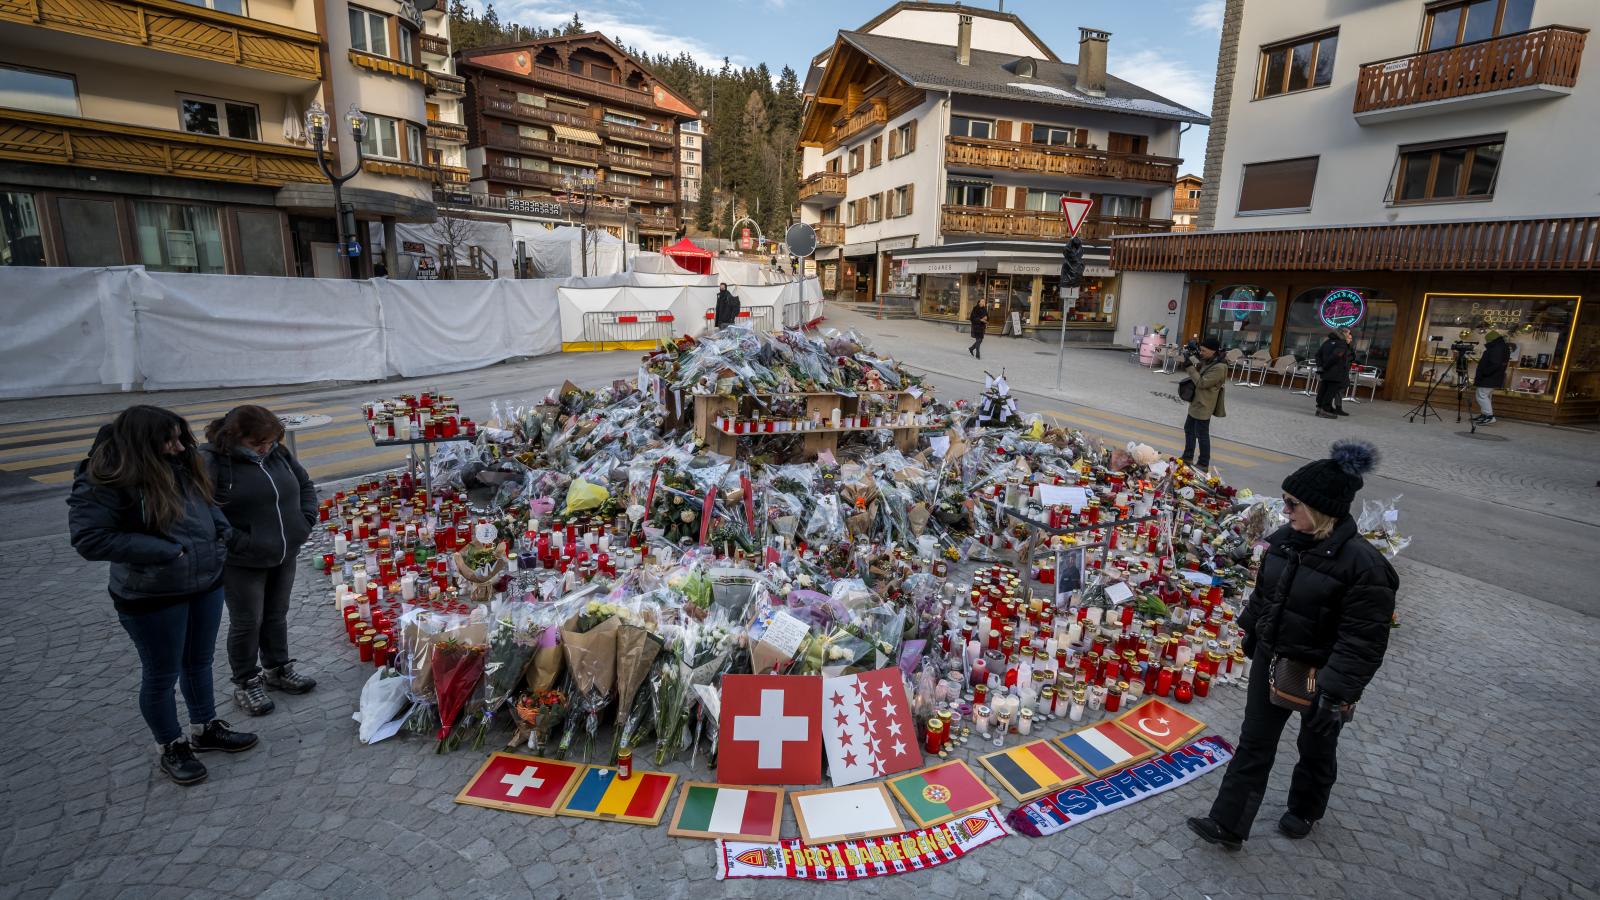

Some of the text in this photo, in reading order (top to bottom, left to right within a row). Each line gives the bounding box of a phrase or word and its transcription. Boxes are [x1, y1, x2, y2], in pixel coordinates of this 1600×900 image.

[1328, 293, 1342, 302] MAX
[1324, 305, 1359, 318] Diner
[1057, 749, 1207, 816] SERBIA
[783, 846, 846, 870] FORÇA
[844, 828, 956, 867] BARREIRENSE
